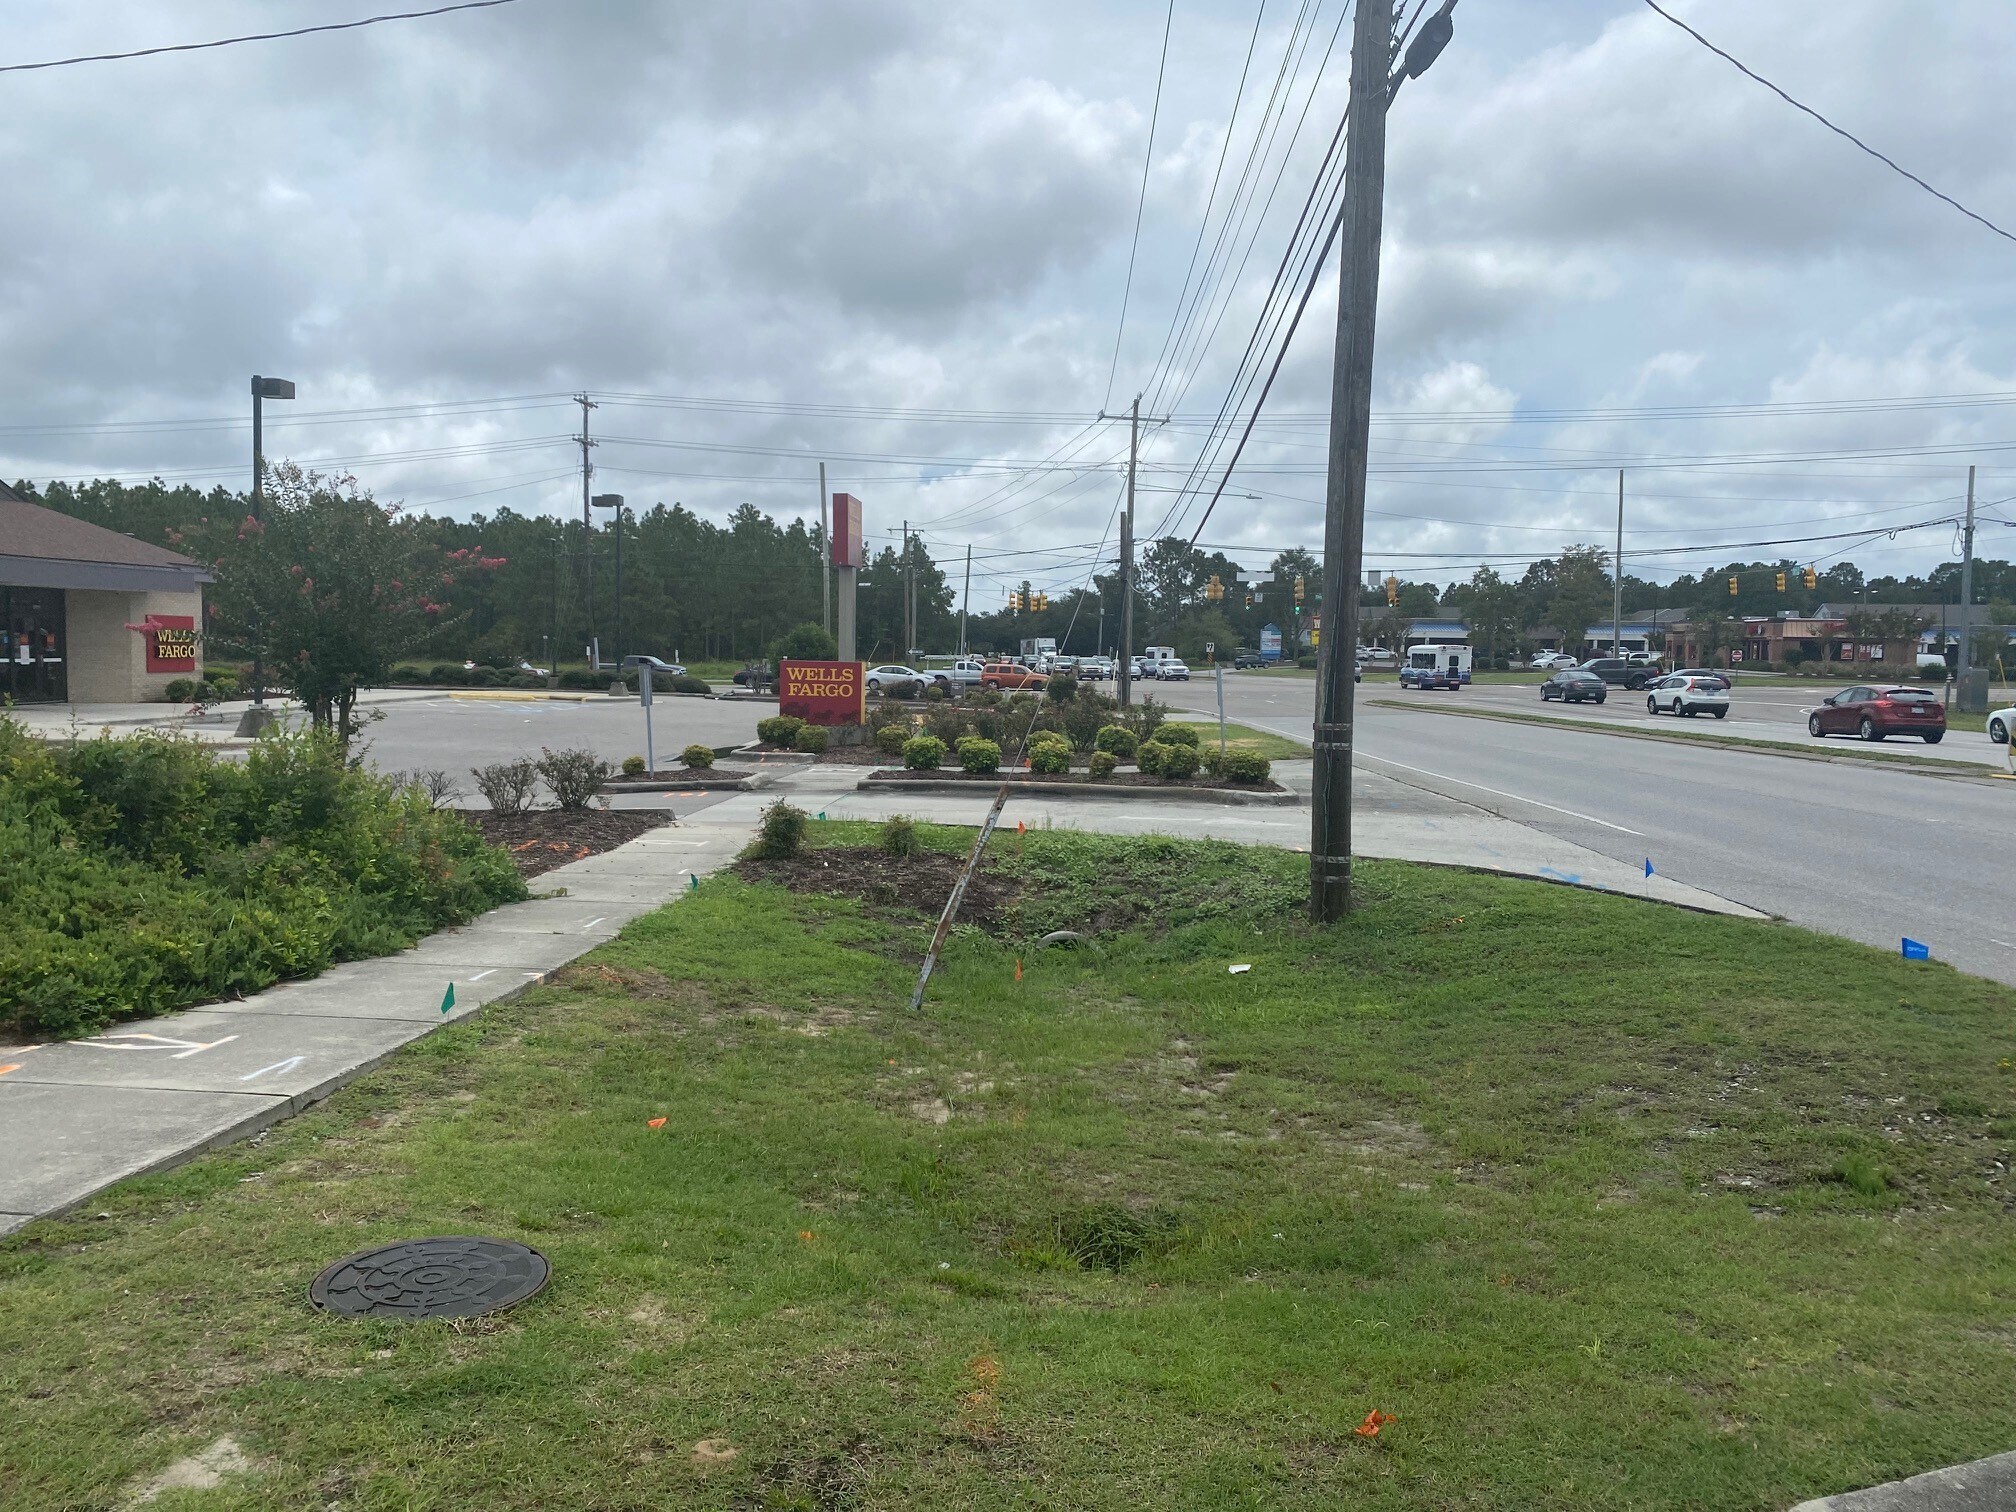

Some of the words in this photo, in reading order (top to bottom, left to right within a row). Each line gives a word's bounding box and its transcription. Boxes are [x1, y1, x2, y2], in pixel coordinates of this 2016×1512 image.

[156, 629, 195, 642] WELL
[158, 645, 195, 658] FARGO
[786, 667, 854, 682] WELLS
[788, 682, 854, 697] FARGO
